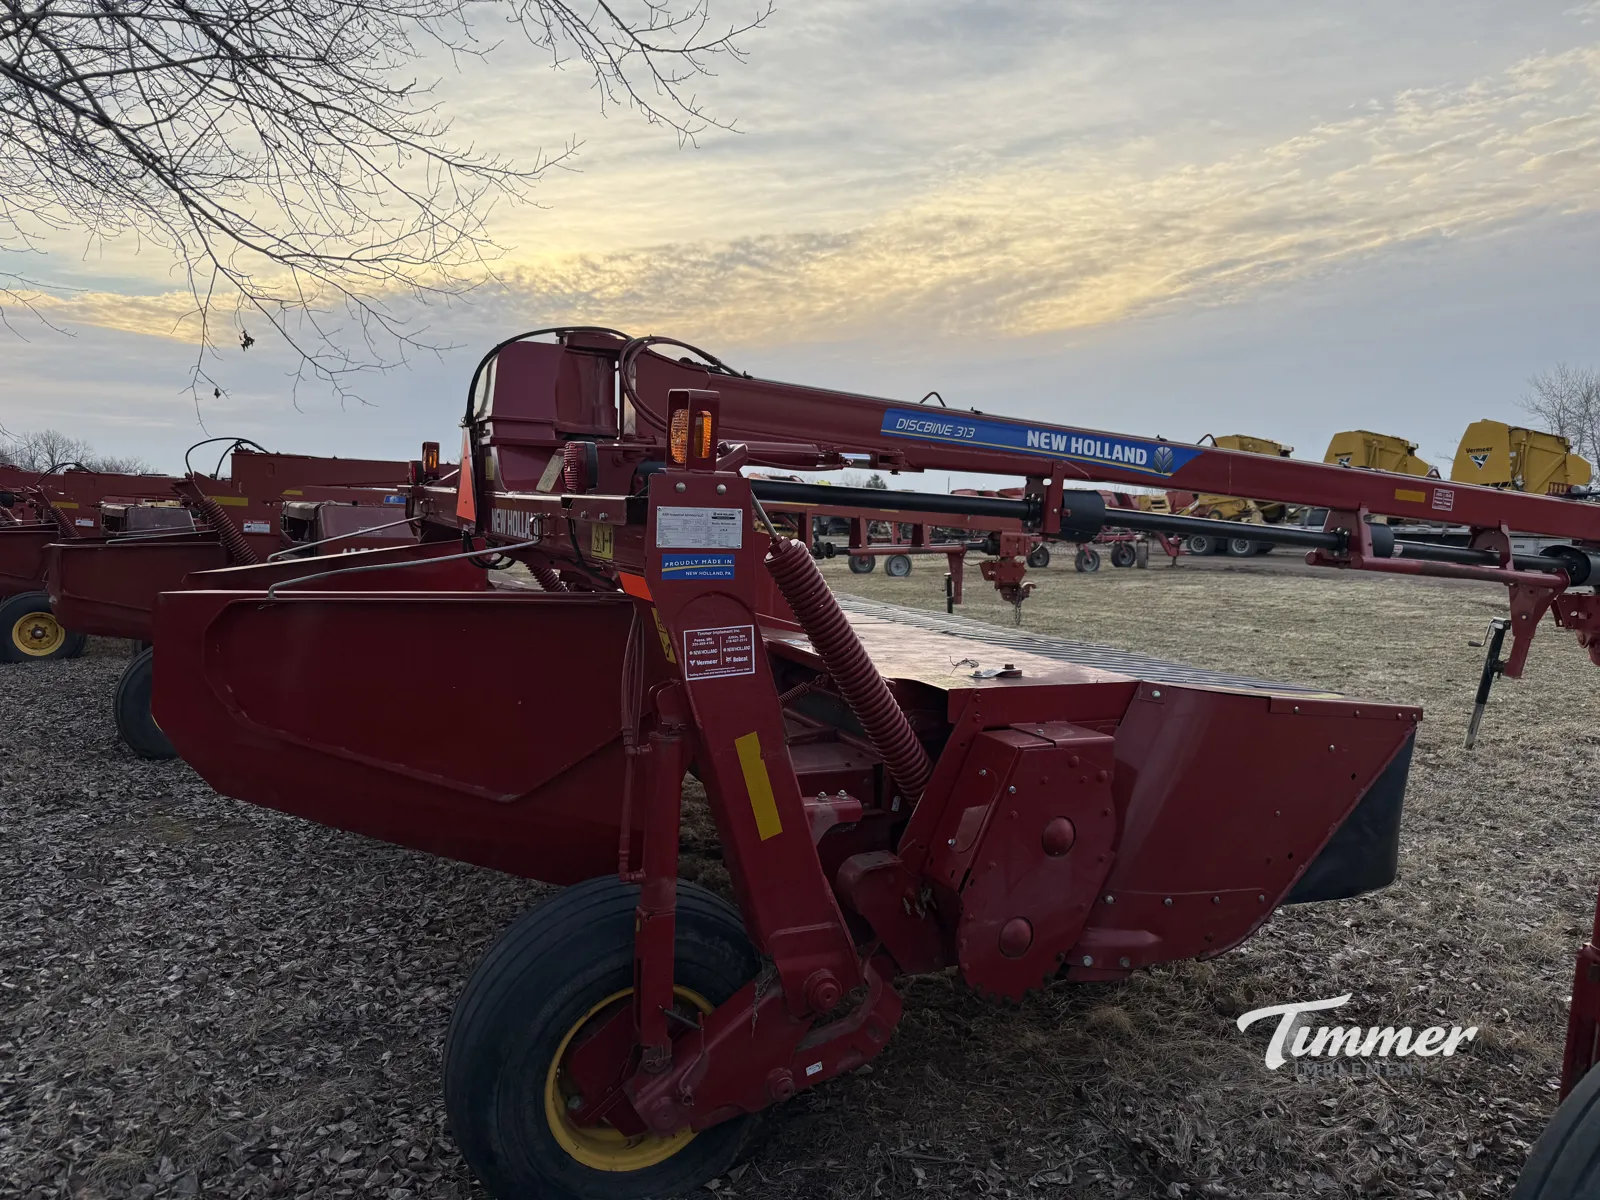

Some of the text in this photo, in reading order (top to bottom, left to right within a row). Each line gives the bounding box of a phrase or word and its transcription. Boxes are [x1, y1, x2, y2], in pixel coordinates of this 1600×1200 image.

[896, 418, 976, 438] DISCBINE 313
[1026, 430, 1148, 465] NEW HOLLAND
[1465, 446, 1493, 454] Vermeer
[492, 508, 506, 534] NEW
[664, 559, 699, 568] PROUDLY
